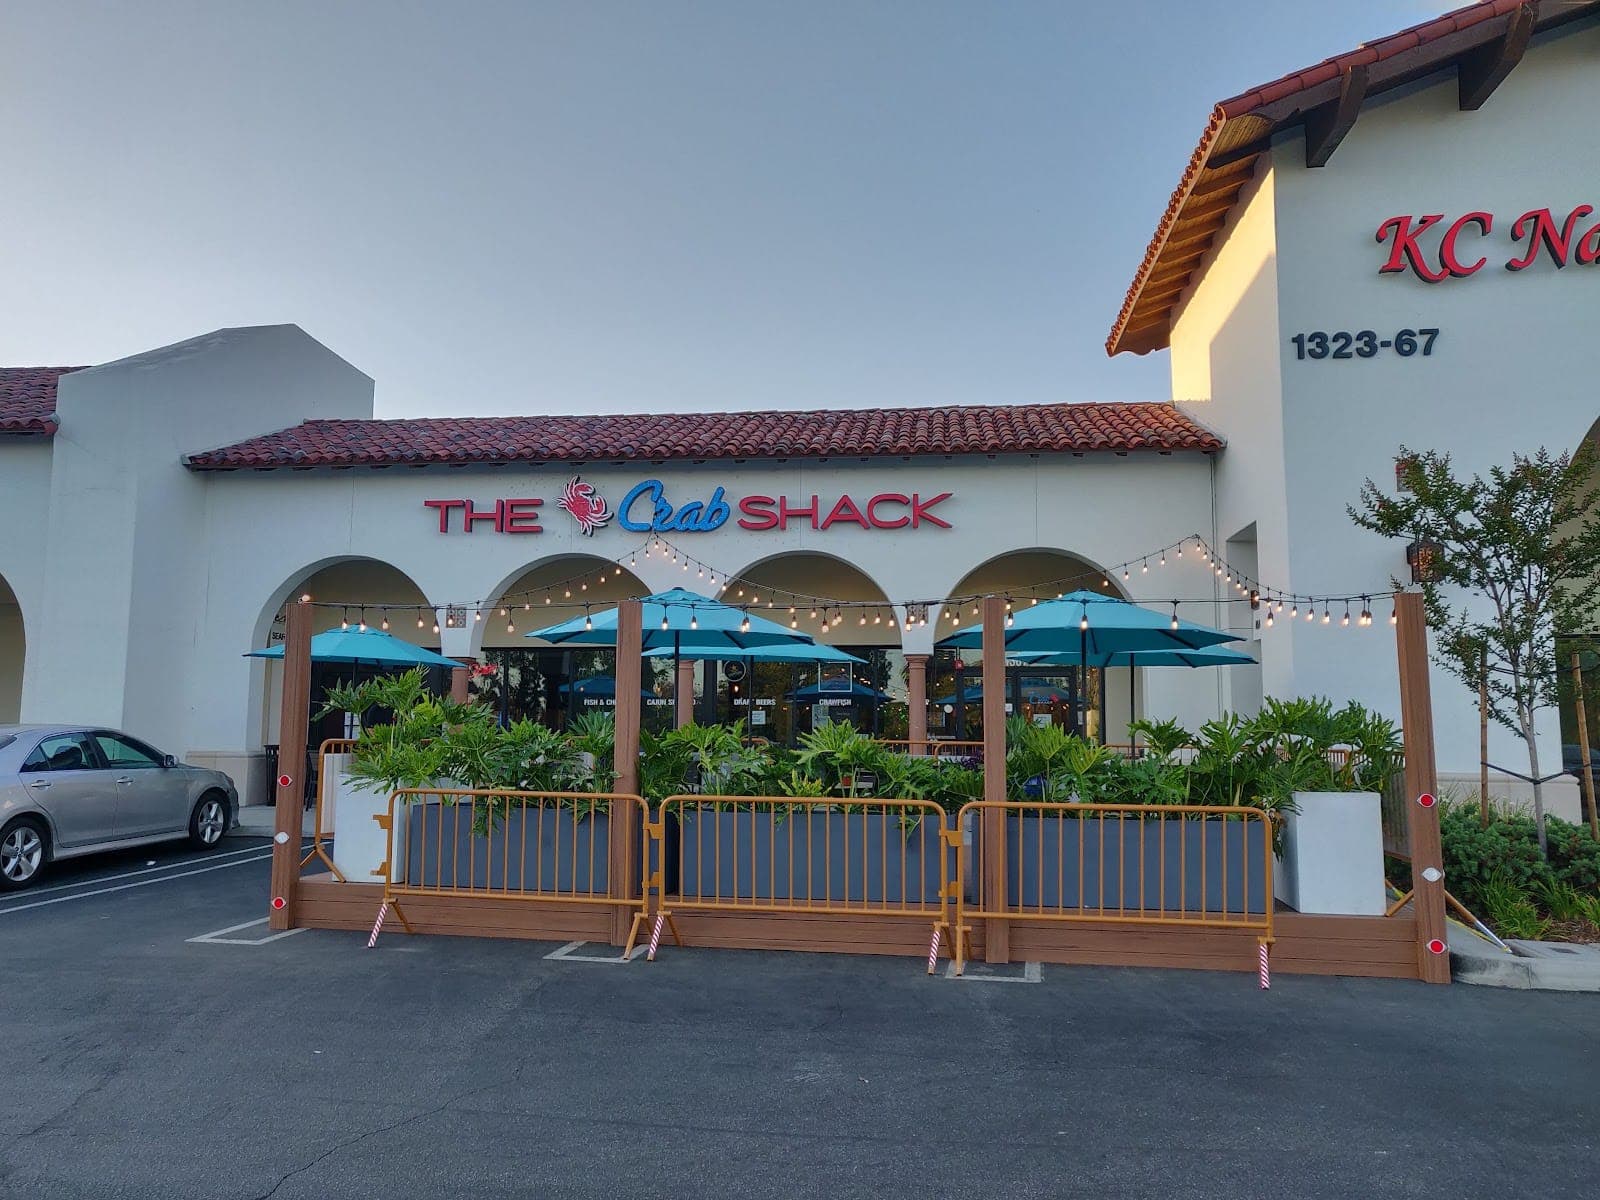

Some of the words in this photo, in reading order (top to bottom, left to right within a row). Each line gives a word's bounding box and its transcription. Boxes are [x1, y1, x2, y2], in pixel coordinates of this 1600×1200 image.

[1376, 211, 1493, 283] KC
[1292, 328, 1439, 360] 1323-67
[424, 498, 544, 533] THE
[617, 479, 731, 532] Crab
[737, 492, 953, 531] SHACK
[583, 698, 599, 706] FISH
[646, 698, 667, 706] CAJUN
